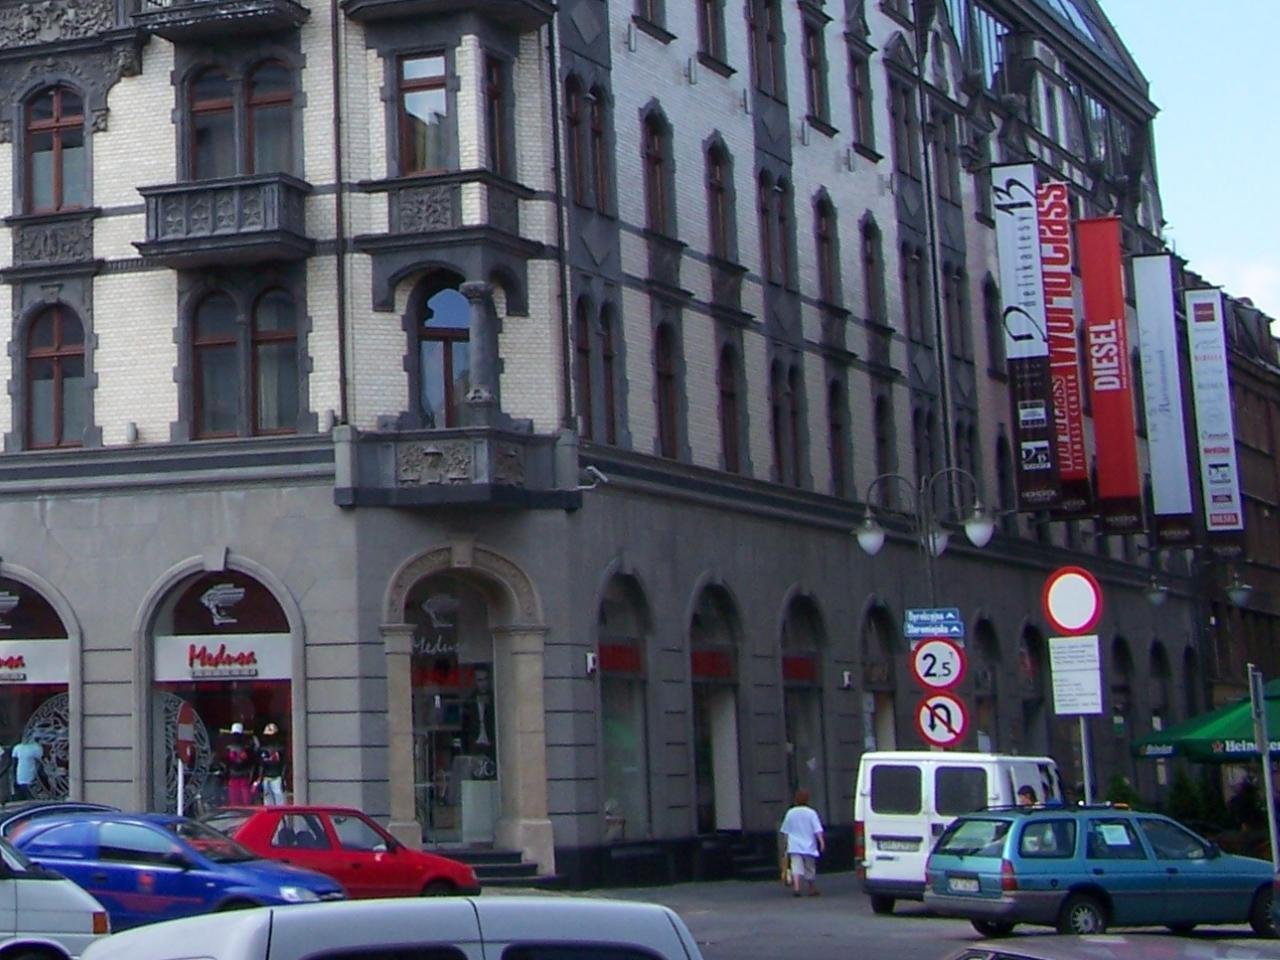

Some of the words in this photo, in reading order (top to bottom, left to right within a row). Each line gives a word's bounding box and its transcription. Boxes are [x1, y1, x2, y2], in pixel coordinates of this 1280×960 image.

[1015, 216, 1037, 308] delikatesy
[1089, 319, 1120, 391] DIESEL
[188, 643, 258, 669] Medusa
[922, 652, 952, 678] 2,5
